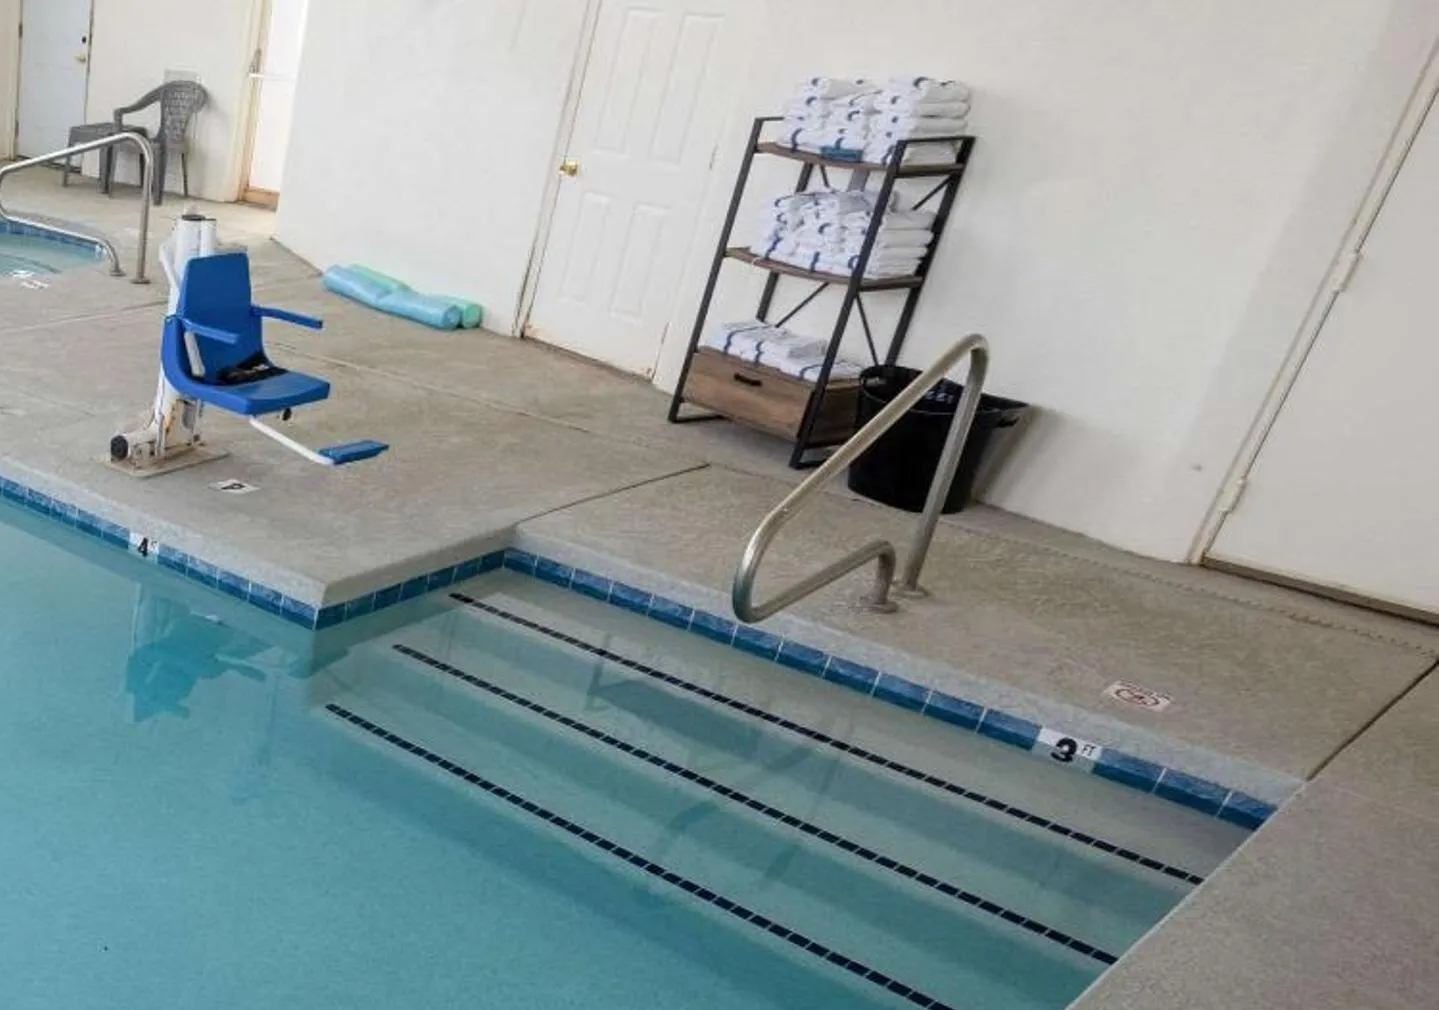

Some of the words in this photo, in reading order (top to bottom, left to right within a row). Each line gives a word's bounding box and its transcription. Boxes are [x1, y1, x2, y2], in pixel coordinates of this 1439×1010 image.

[137, 536, 149, 558] 4
[1050, 736, 1078, 763] 3
[1081, 744, 1097, 757] FT
